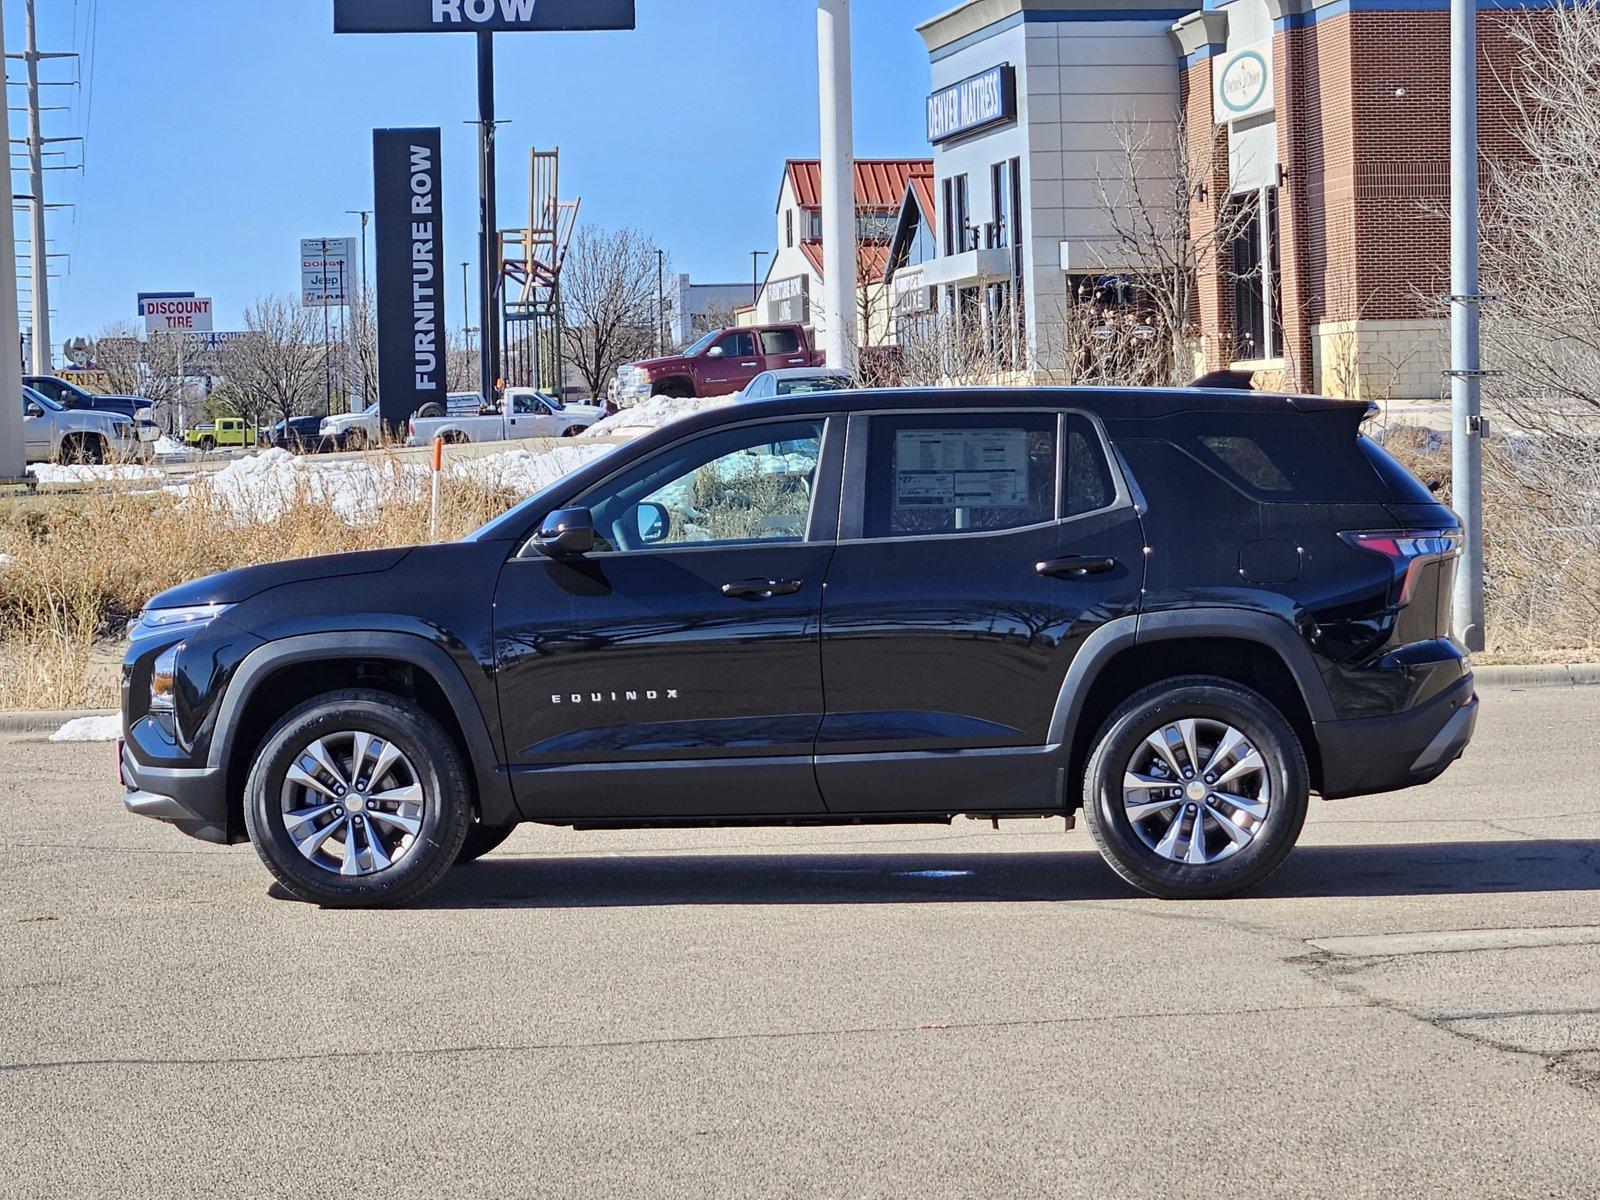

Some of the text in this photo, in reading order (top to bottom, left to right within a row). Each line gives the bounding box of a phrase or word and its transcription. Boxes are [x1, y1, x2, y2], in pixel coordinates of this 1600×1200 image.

[432, 0, 536, 22] ROW
[928, 71, 999, 137] DENVER MATTRESS
[410, 145, 437, 390] FURNITURE ROW
[310, 275, 338, 286] Jeep
[147, 301, 209, 315] DISCOUNT
[166, 316, 193, 328] TIRE
[551, 689, 678, 704] EQUINOX
